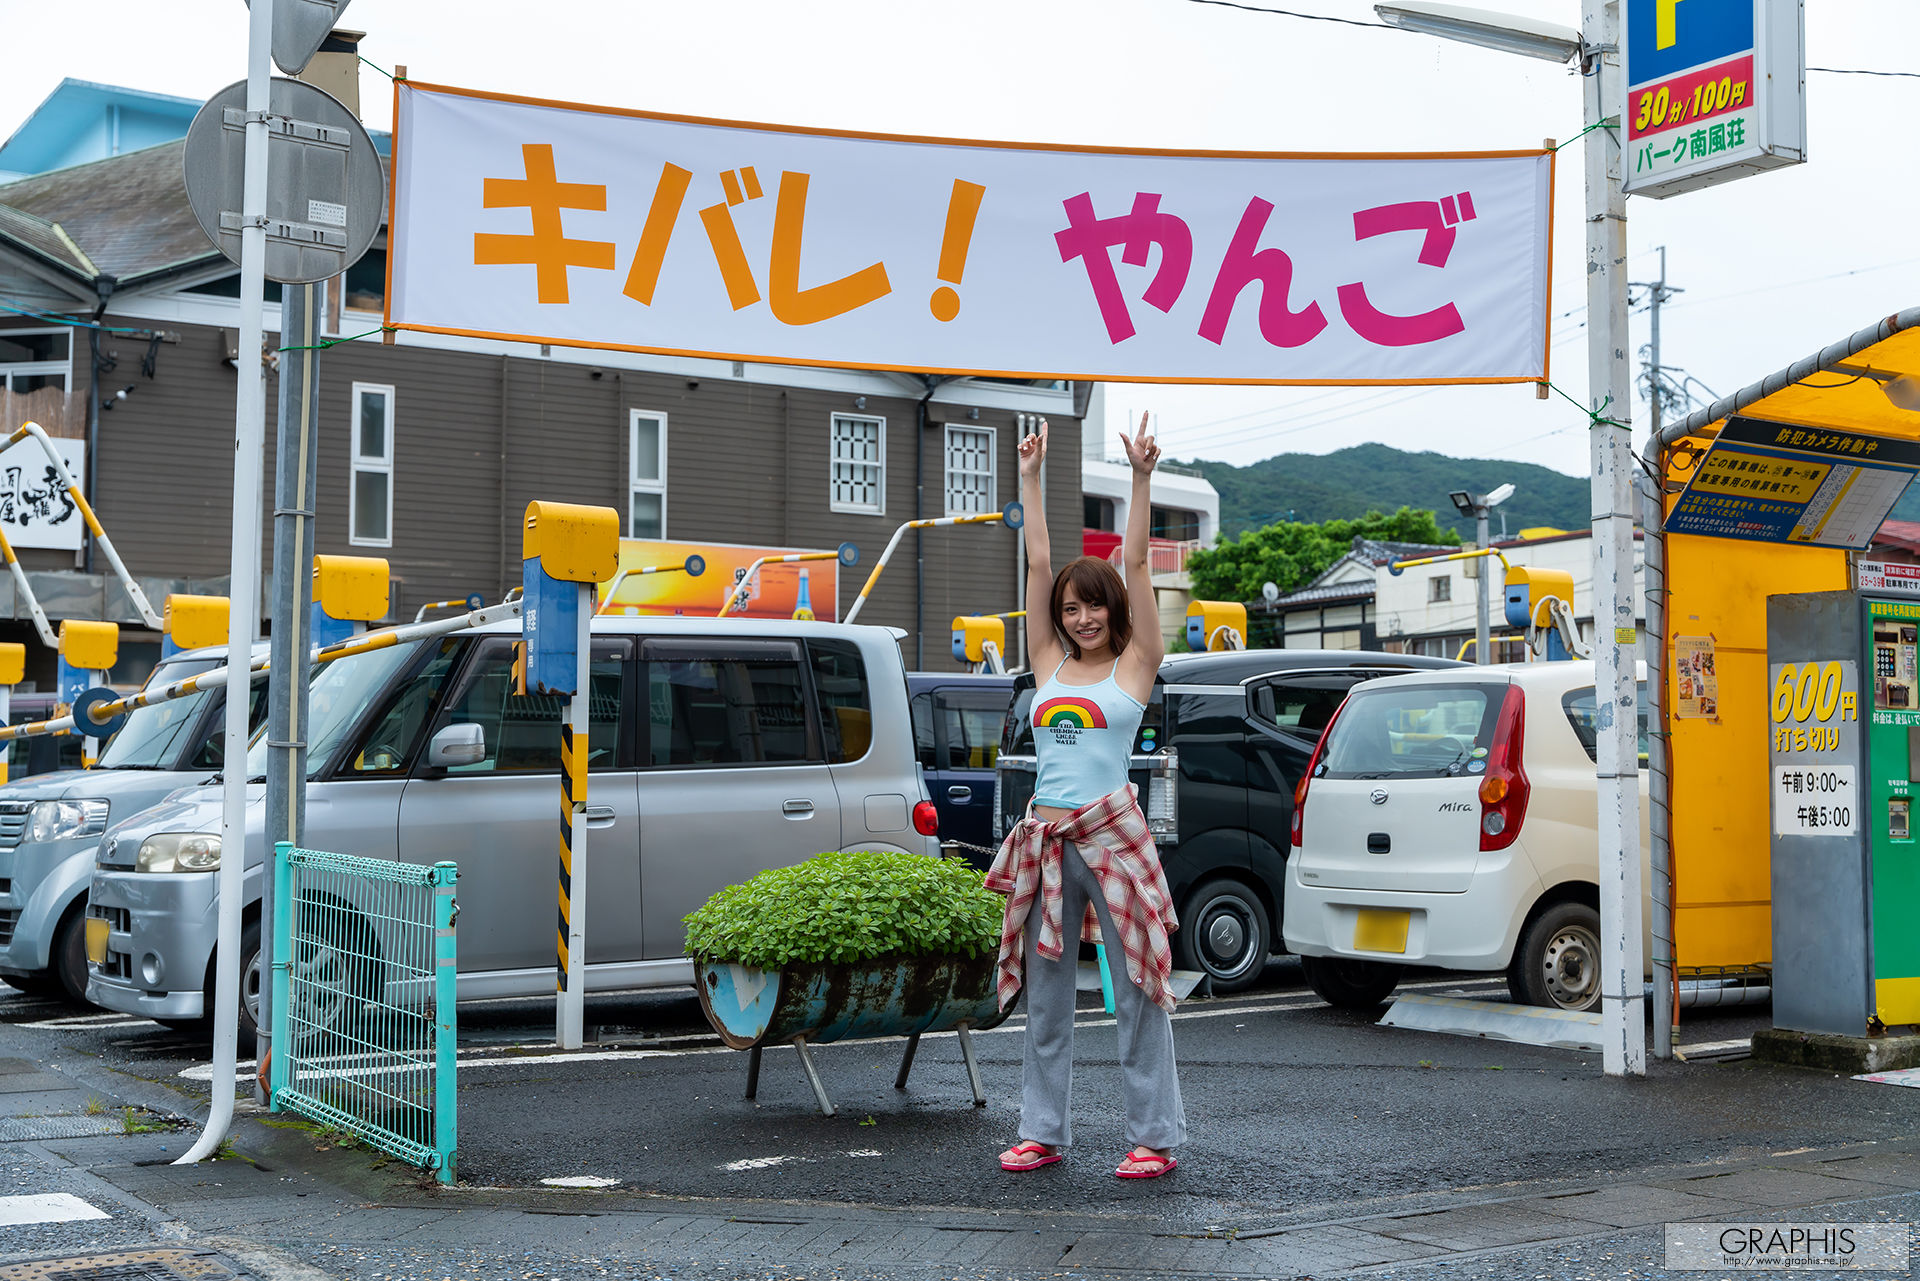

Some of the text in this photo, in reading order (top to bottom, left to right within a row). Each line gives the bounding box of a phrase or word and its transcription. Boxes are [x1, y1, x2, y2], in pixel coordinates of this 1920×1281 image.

[1635, 76, 1747, 132] 30分/100円
[1637, 117, 1745, 173] パーク南風荘
[1053, 191, 1477, 348] やんご
[1775, 428, 1879, 455] 防犯カメラ作動中
[1772, 661, 1858, 722] 600円
[1775, 727, 1839, 752] 打ち切り
[1438, 802, 1473, 812] Mira
